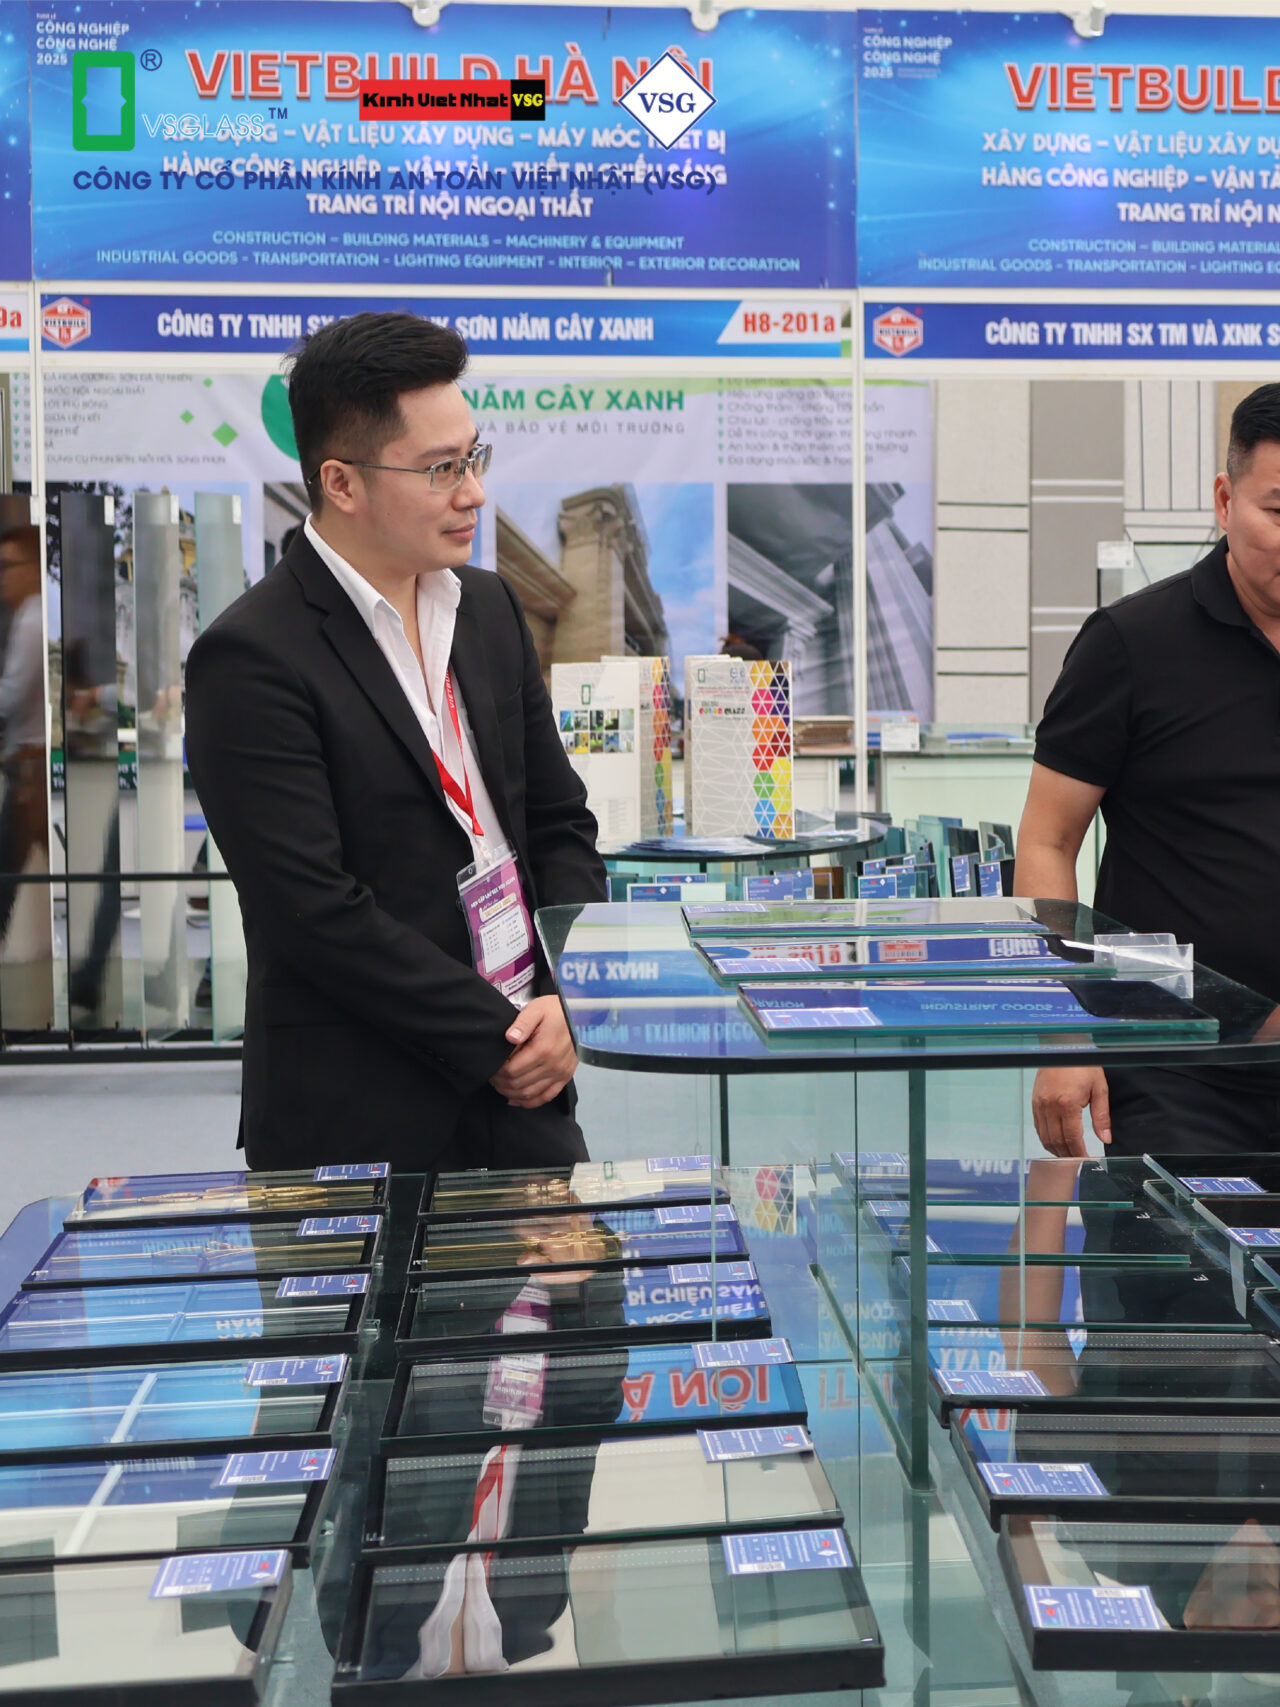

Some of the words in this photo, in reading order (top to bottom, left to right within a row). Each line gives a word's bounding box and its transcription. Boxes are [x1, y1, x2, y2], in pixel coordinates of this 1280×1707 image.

[36, 20, 75, 34] CÔNG
[78, 21, 130, 36] NGHIỆP
[36, 36, 75, 50] CÔNG
[863, 34, 901, 48] CÔNG
[903, 35, 952, 50] NGHIỆP
[36, 53, 68, 66] 2025
[863, 51, 901, 64] CÔNG
[903, 51, 940, 66] NGHỆ
[612, 45, 713, 106] NI
[863, 66, 893, 79] 2025
[301, 119, 342, 148] VẬT
[349, 120, 395, 149] LIỆU
[401, 121, 448, 145] XÂY
[453, 125, 514, 150] DỰNG
[537, 122, 587, 148] MÁY
[592, 123, 641, 149] MÓC
[707, 129, 726, 155] BỊ
[982, 128, 1027, 152] XÂY
[1033, 132, 1092, 156] DỰNG
[1114, 130, 1152, 158] VẬT
[1157, 131, 1202, 158] LIỆU
[1207, 131, 1250, 154] XÂY
[163, 151, 226, 178] HÀNG
[982, 163, 1042, 188] HÀNG
[1047, 163, 1108, 189] CÔNG
[1113, 164, 1189, 193] NGHIỆP
[1211, 165, 1254, 194] VẬN
[306, 193, 378, 216] TRANG
[383, 189, 416, 215] TRÍ
[420, 190, 459, 220] NỘI
[465, 195, 537, 221] NGOẠI
[540, 187, 594, 218] THẤT
[1117, 202, 1185, 223] TRANG
[1190, 198, 1220, 223] TRÍ
[1225, 199, 1262, 228] NỘI
[212, 231, 326, 247] CONSTRUCTION
[342, 232, 409, 248] BUILDING
[413, 233, 489, 248] MATERIALS
[506, 234, 588, 249] MACHINERY
[591, 235, 601, 249] &
[605, 235, 684, 251] EQUIPMENT
[1028, 239, 1136, 252] CONSTRUCTION
[1152, 240, 1215, 253] BUILDING
[96, 249, 179, 264] INDUSTRIAL
[183, 250, 238, 265] GOODS
[252, 251, 379, 267] TRANSPORTATION
[394, 253, 460, 268] LIGHTING
[464, 254, 544, 269] EQUIPMENT
[559, 255, 624, 270] INTERIOR
[639, 256, 705, 271] EXTERIOR
[708, 257, 800, 272] DECORATION
[918, 258, 996, 272] INDUSTRIAL
[1000, 259, 1053, 272] GOODS
[1067, 259, 1187, 273] TRANSPORTATION
[1201, 260, 1264, 273] LIGHTING
[157, 308, 214, 338] CÔNG
[216, 313, 242, 338] TY
[248, 314, 301, 339] TNHH
[455, 315, 497, 341] SƠN
[502, 312, 550, 341] NĂM
[554, 312, 597, 341] CÂY
[599, 317, 655, 341] XANH
[743, 311, 836, 334] H8-201a
[985, 317, 1039, 345] CÔNG
[1044, 322, 1067, 345] TY
[1071, 322, 1122, 345] TNHH
[1127, 322, 1154, 346] SX
[1157, 322, 1187, 345] TM
[1192, 318, 1218, 346] VÀ
[1222, 322, 1263, 346] XNK
[461, 384, 525, 411] NĂM
[535, 383, 594, 411] CÂY
[605, 389, 685, 411] XANH
[506, 419, 540, 434] BẢO
[576, 419, 609, 434] MÔI
